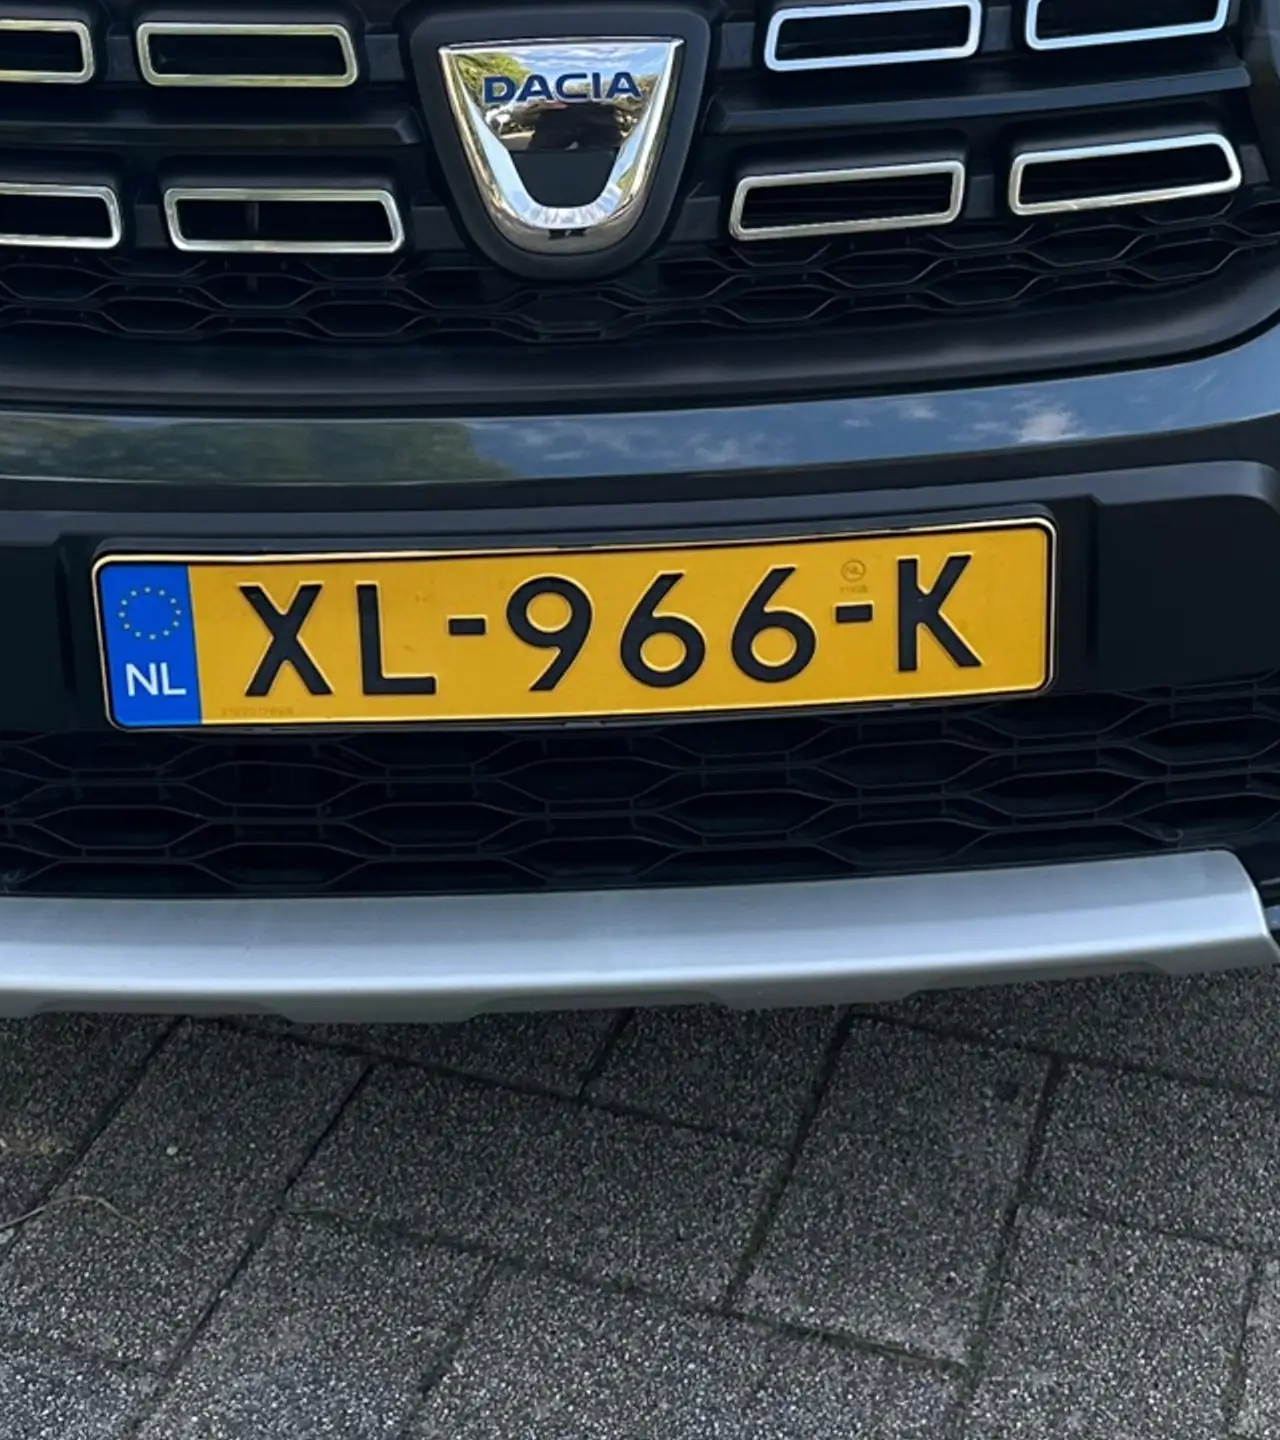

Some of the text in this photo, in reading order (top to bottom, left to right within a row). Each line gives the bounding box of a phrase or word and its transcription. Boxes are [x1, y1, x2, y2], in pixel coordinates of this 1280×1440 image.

[482, 71, 642, 104] DACIA
[240, 553, 984, 698] XL-966-K
[125, 662, 188, 697] NL
